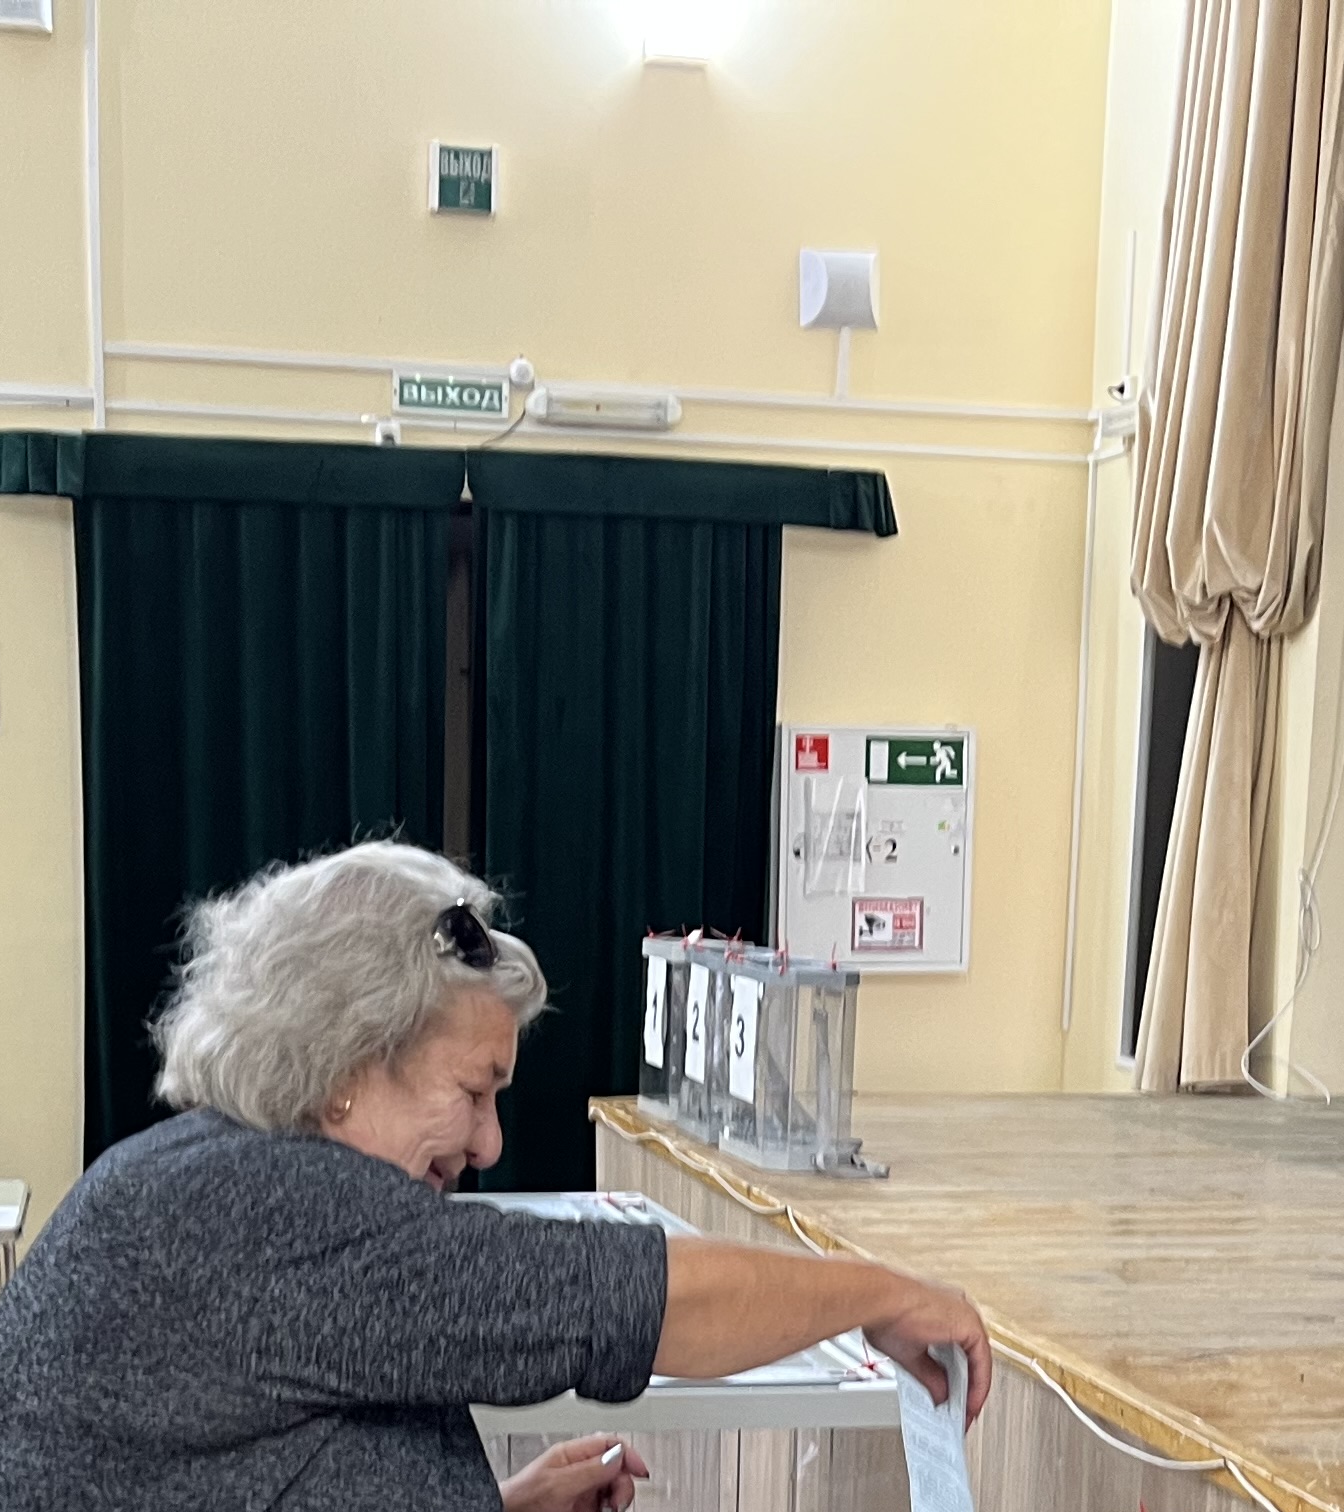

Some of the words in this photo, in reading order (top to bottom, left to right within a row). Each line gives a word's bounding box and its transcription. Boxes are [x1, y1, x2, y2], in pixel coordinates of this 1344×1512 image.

[441, 150, 491, 184] ВЫХОД
[403, 383, 500, 411] ВЫХОД
[692, 1000, 699, 1042] 2
[735, 1015, 745, 1058] 3
